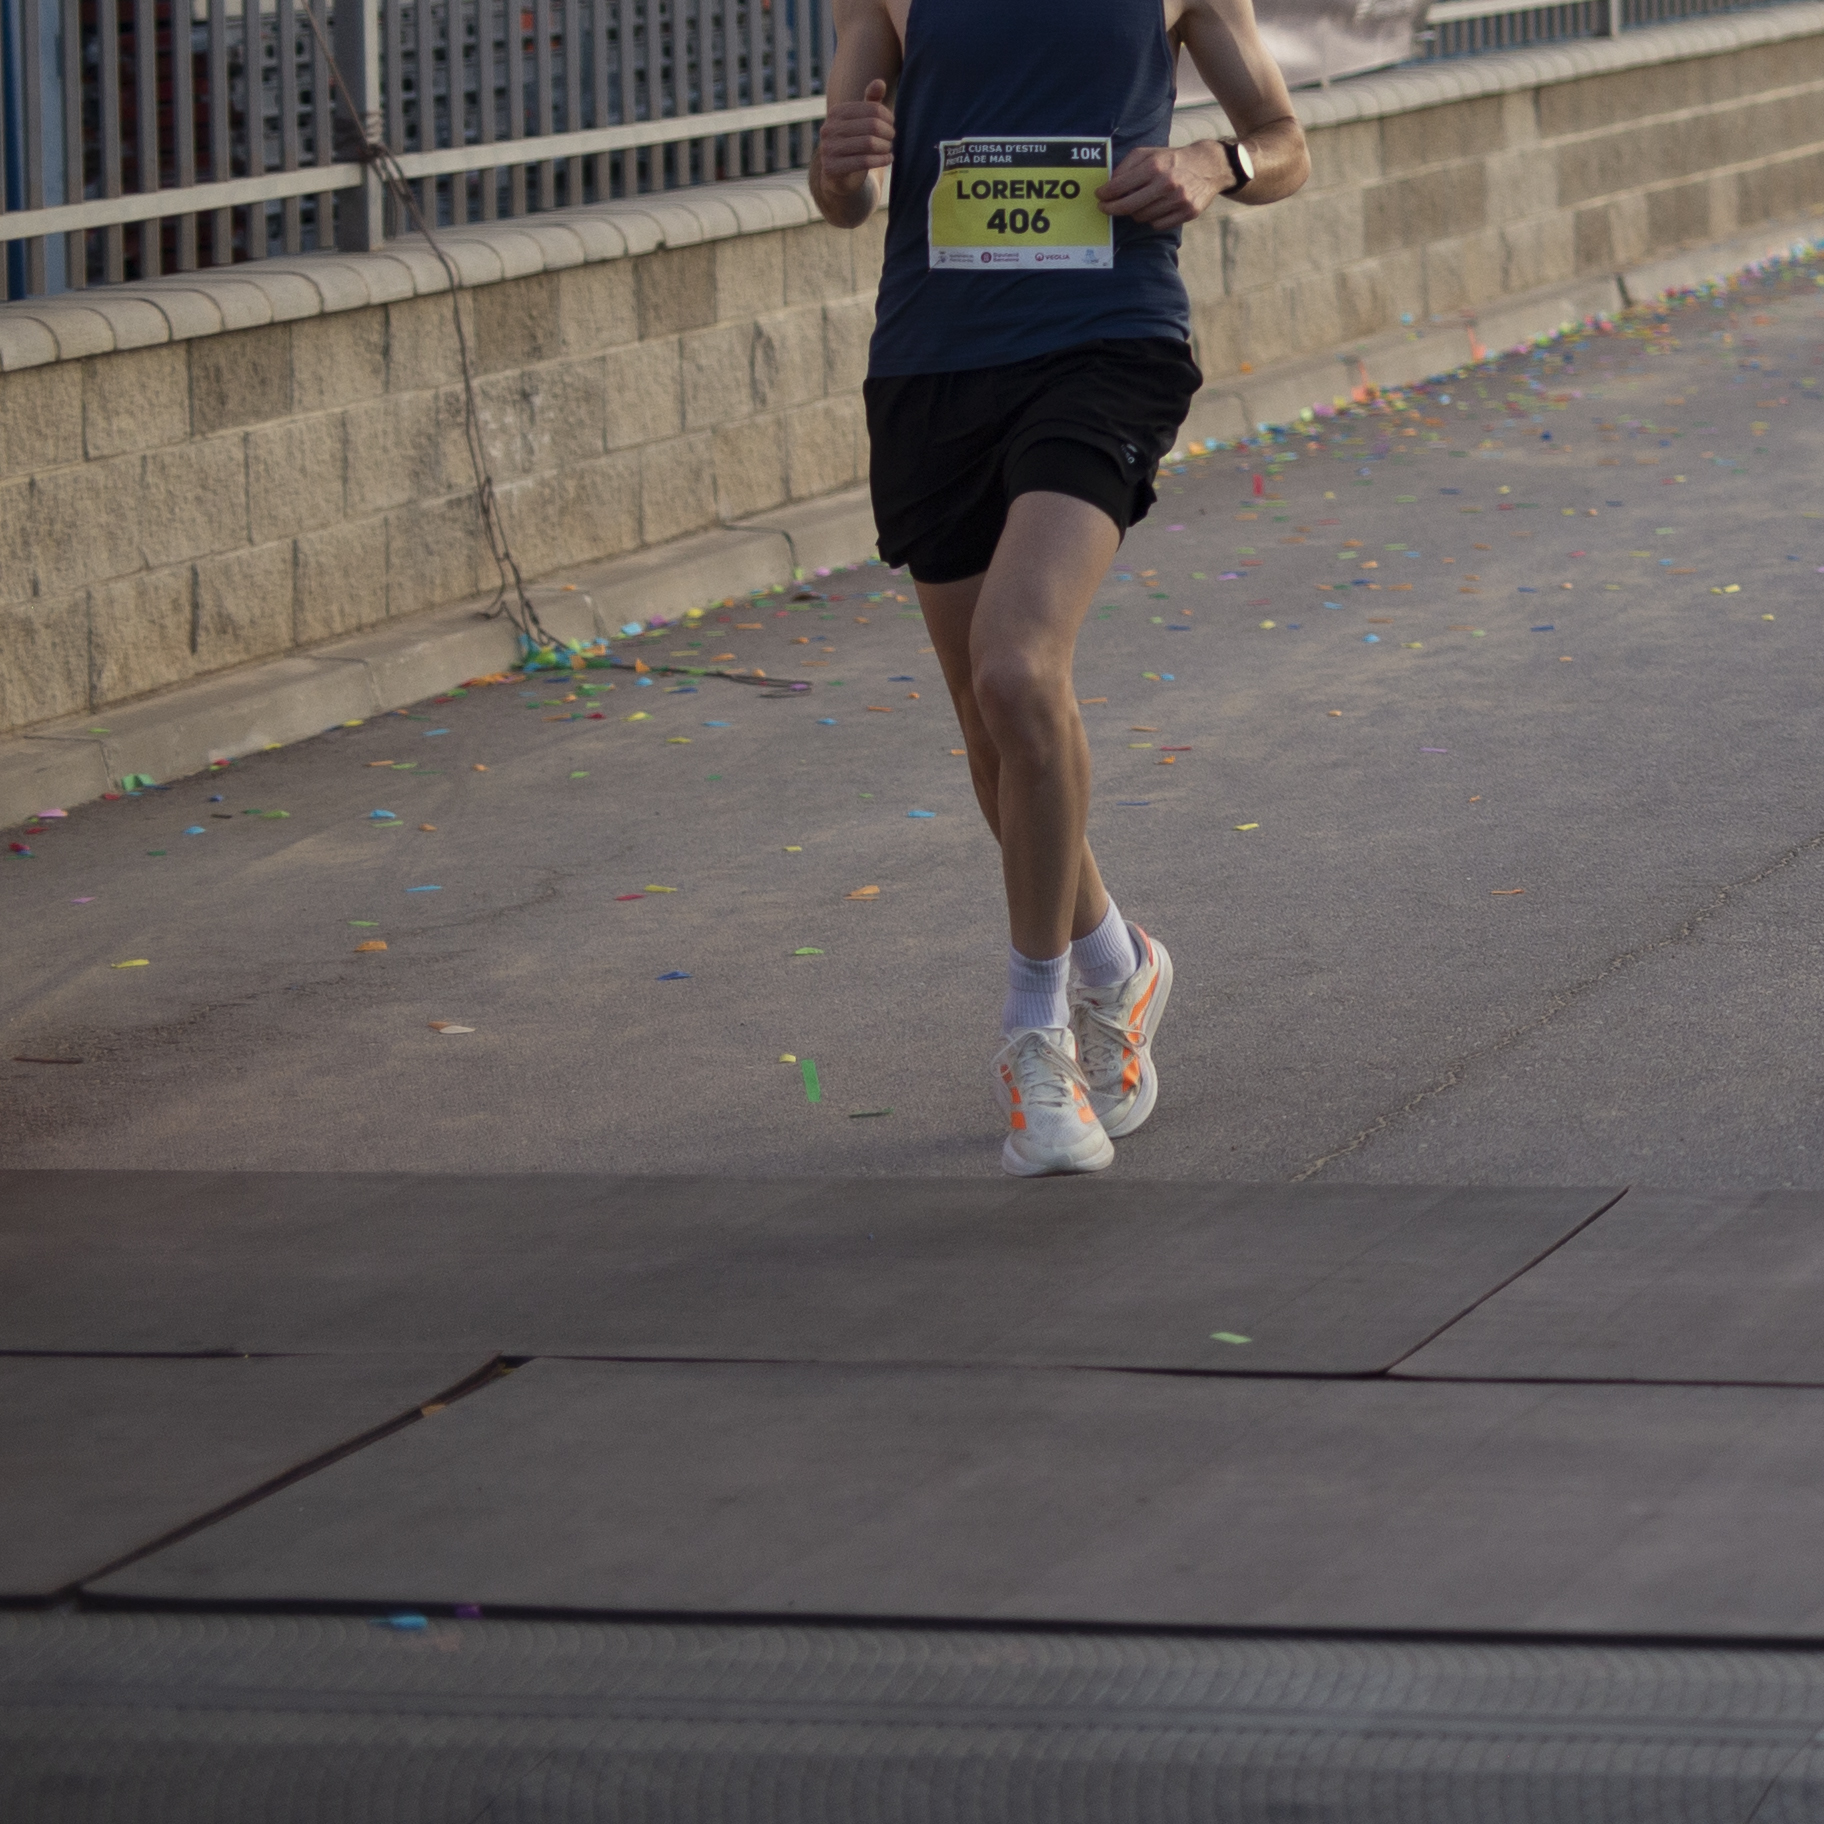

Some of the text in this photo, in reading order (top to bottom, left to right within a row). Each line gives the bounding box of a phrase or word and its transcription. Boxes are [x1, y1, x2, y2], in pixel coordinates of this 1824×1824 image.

[968, 144, 1002, 153] CURSA
[1070, 147, 1102, 160] 10K
[973, 155, 987, 163] DE
[990, 155, 1012, 163] MAR
[956, 179, 1081, 200] LORENZO
[986, 208, 1051, 234] 406
